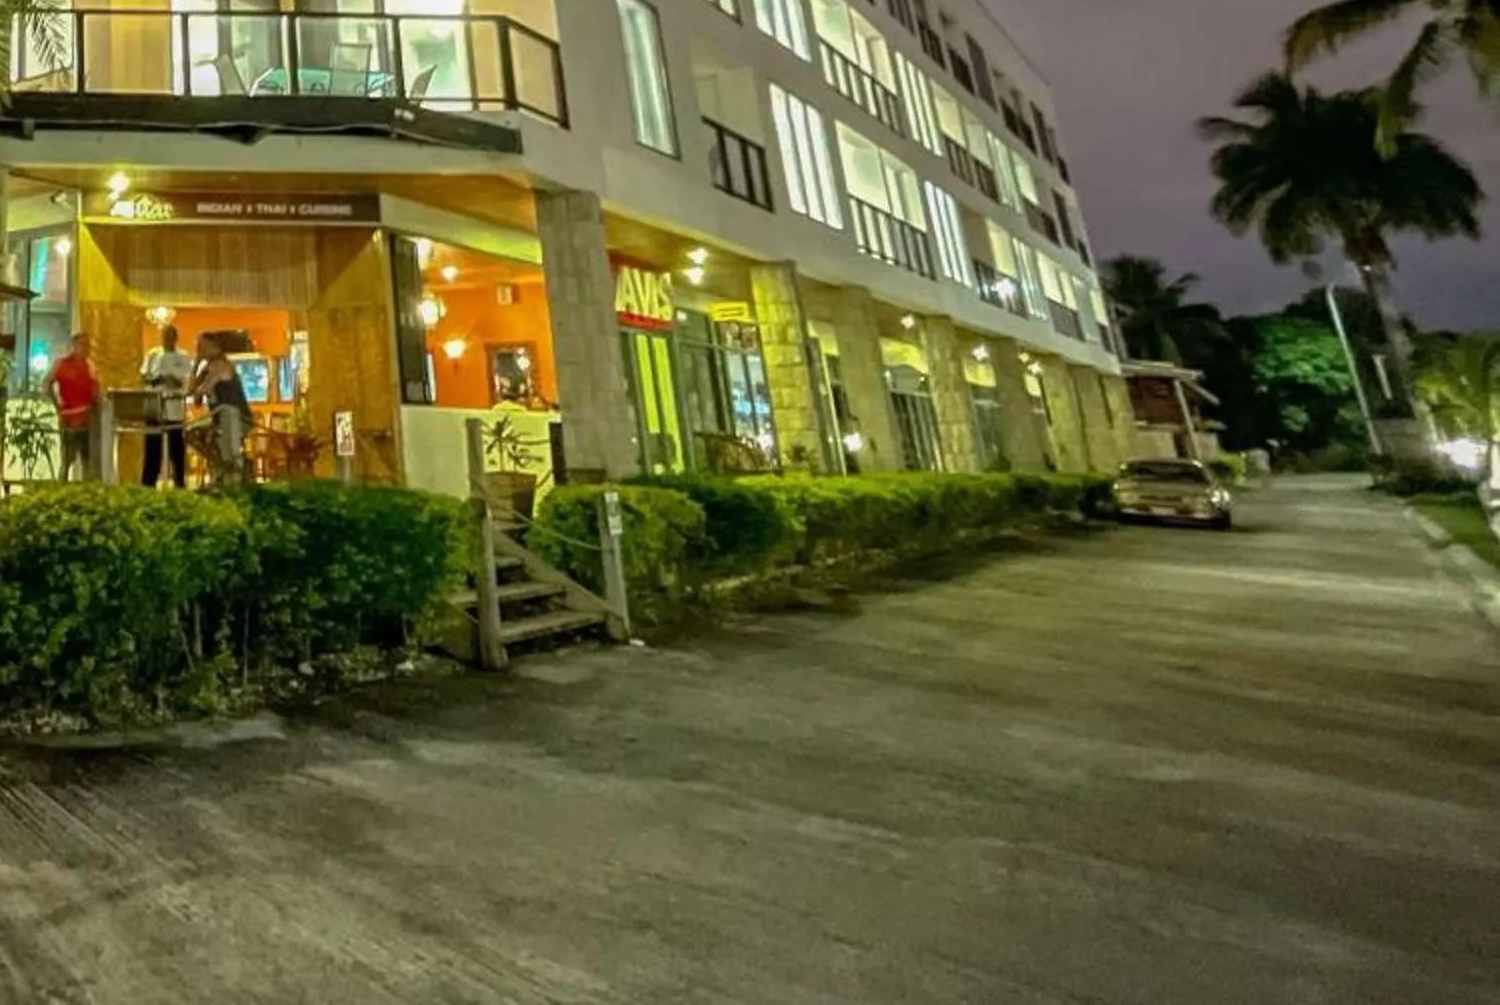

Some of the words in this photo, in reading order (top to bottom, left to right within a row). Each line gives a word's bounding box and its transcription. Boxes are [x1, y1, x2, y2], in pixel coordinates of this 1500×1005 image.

[196, 202, 242, 214] INDIAN
[256, 202, 287, 215] THAI
[299, 203, 353, 215] CUISINE
[614, 266, 674, 321] AVIS
